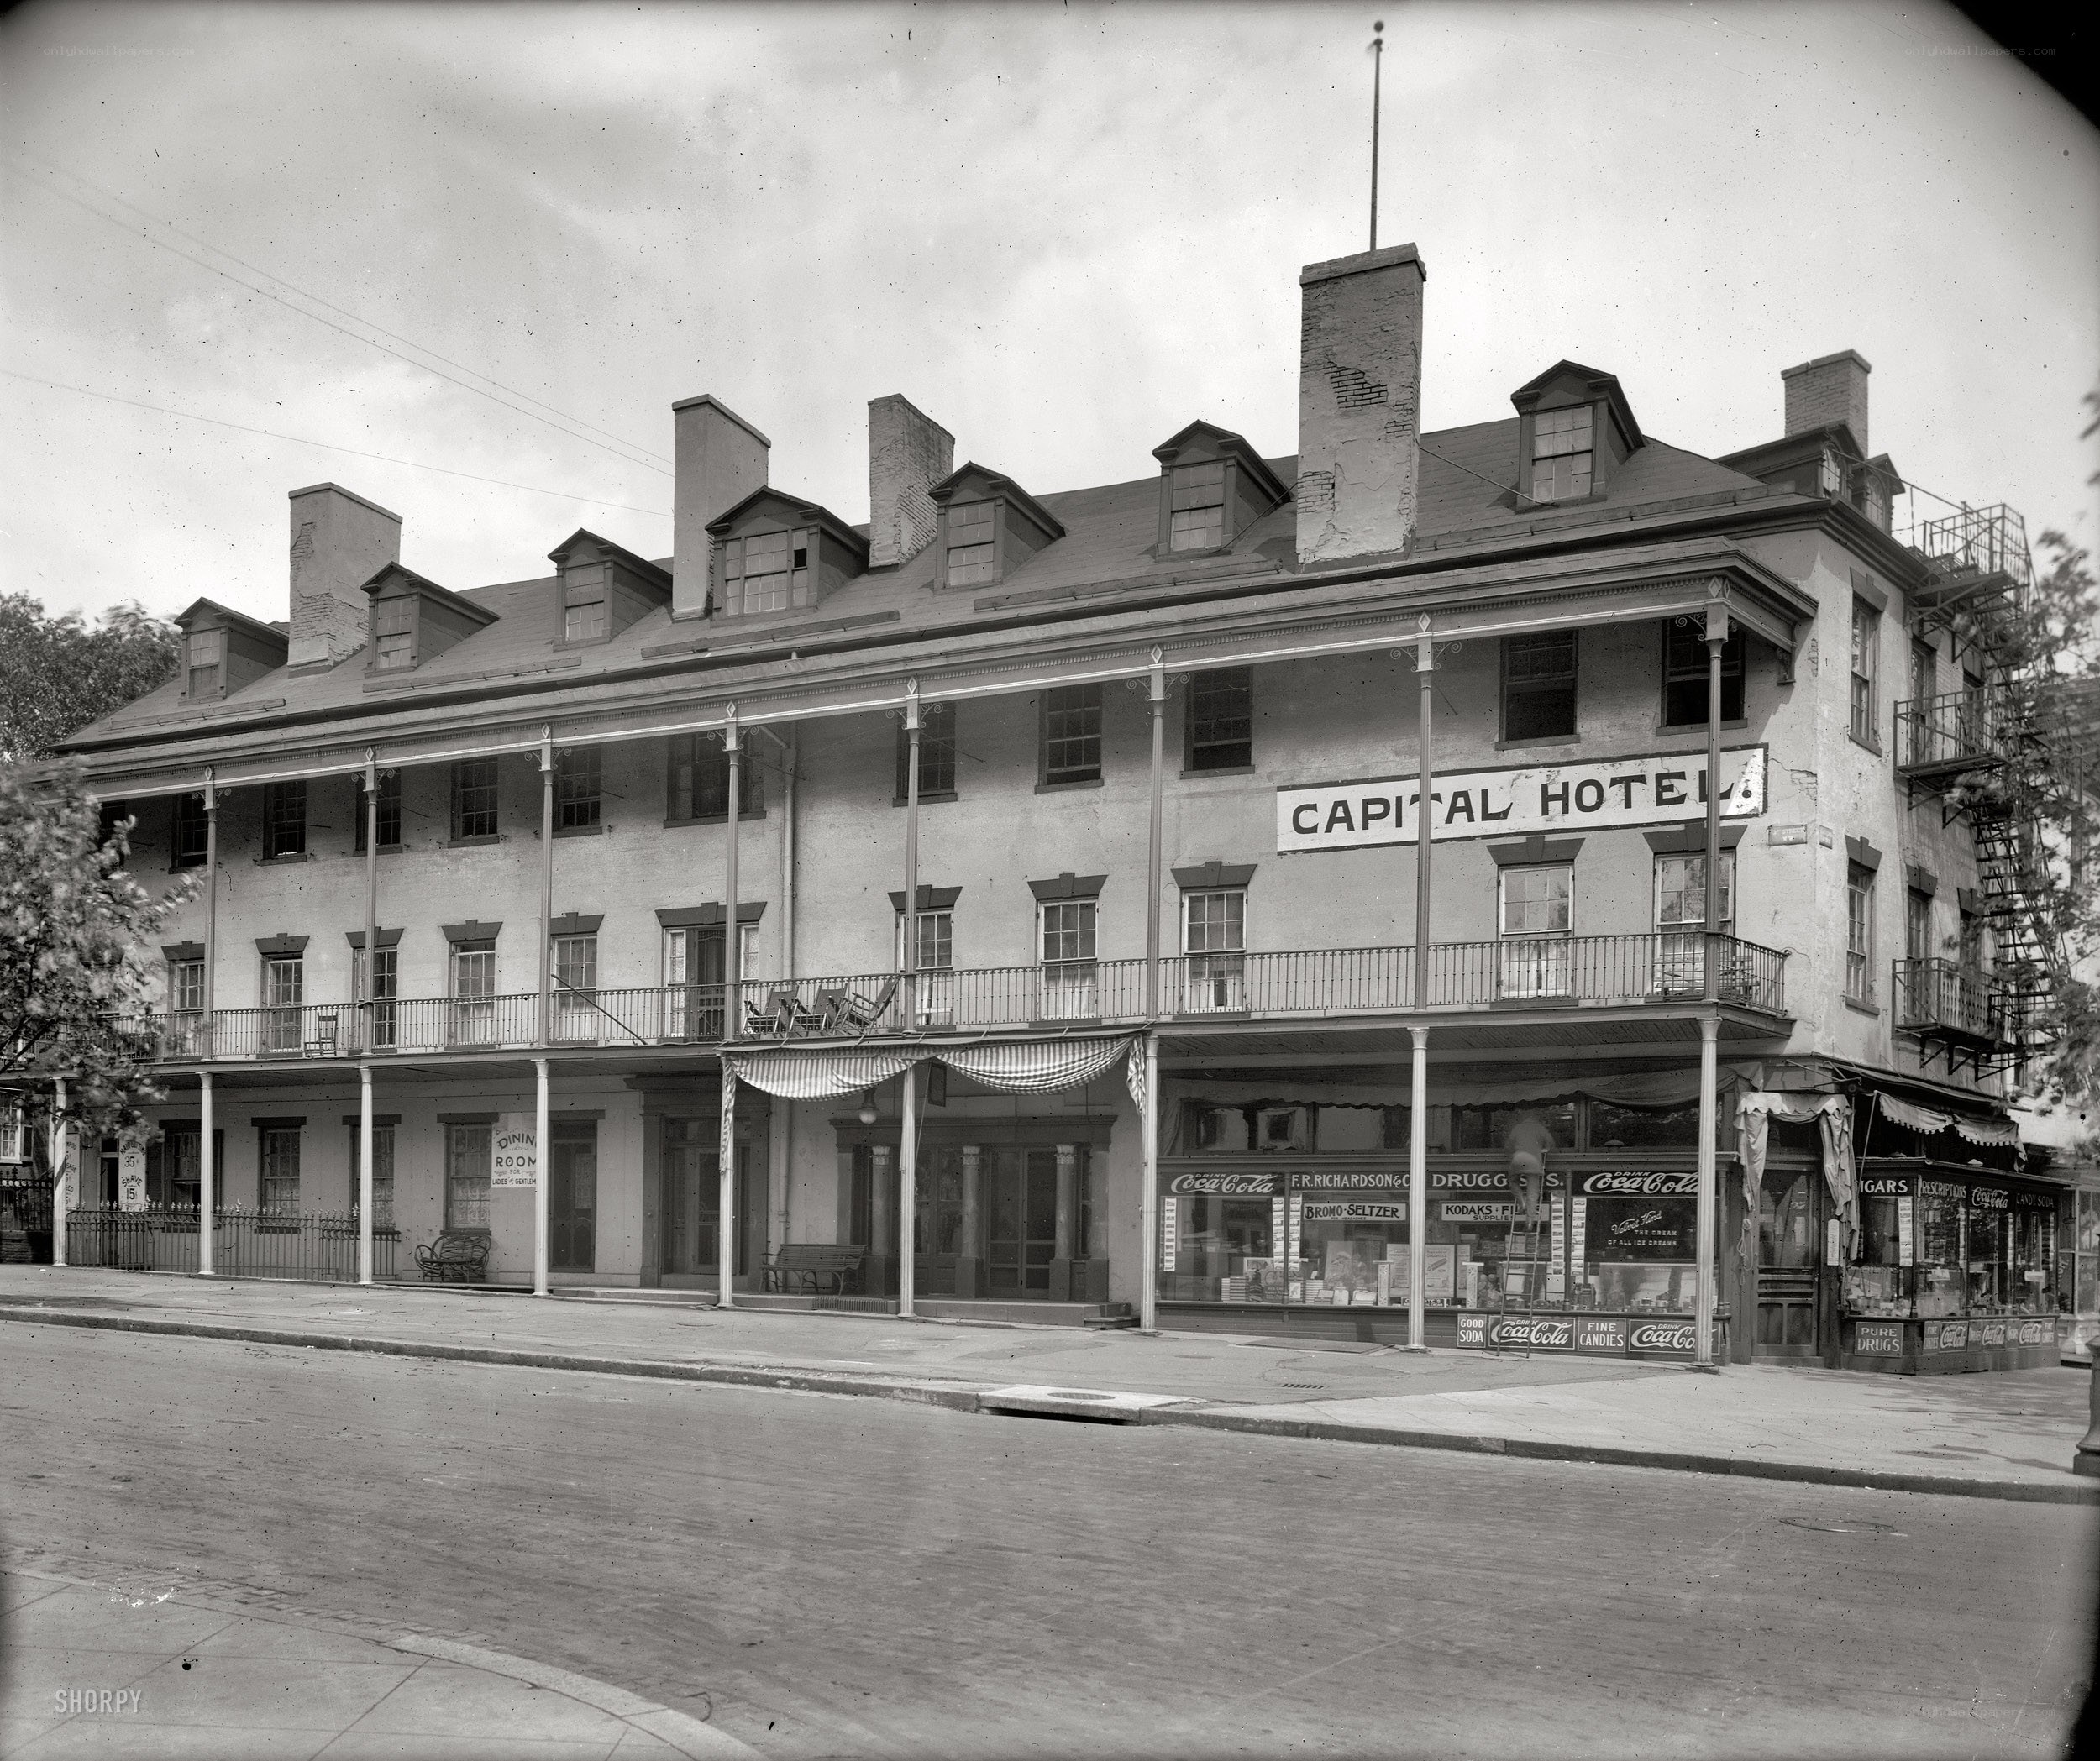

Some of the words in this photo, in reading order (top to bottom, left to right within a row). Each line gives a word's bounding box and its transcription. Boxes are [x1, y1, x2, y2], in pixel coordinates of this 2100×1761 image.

[496, 1133, 536, 1151] DININ
[122, 1175, 143, 1187] SHAVE
[1170, 1174, 1278, 1194] Coca-Cola
[1431, 1173, 1564, 1187] DRUGGSS.
[1861, 1179, 1908, 1193] IGARS
[1971, 1187, 2009, 1208] Coca-Cola
[2016, 1193, 2036, 1206] CANDY
[2037, 1195, 2055, 1208] SODA
[1305, 1203, 1400, 1219] BROMO-SELTZER
[1446, 1205, 1493, 1215] KODAKS
[1610, 1219, 1639, 1235] Velvet
[1640, 1210, 1662, 1225] Kind
[1460, 1318, 1484, 1329] GOOD
[1587, 1323, 1617, 1332] FINE
[1459, 1330, 1484, 1343] SODA
[1490, 1321, 1573, 1344] Coca-Cola
[1630, 1324, 1718, 1350] Coca-Co
[1861, 1327, 1898, 1336] PURE
[1579, 1334, 1625, 1347] CANDIES
[1857, 1338, 1900, 1352] DRUGS
